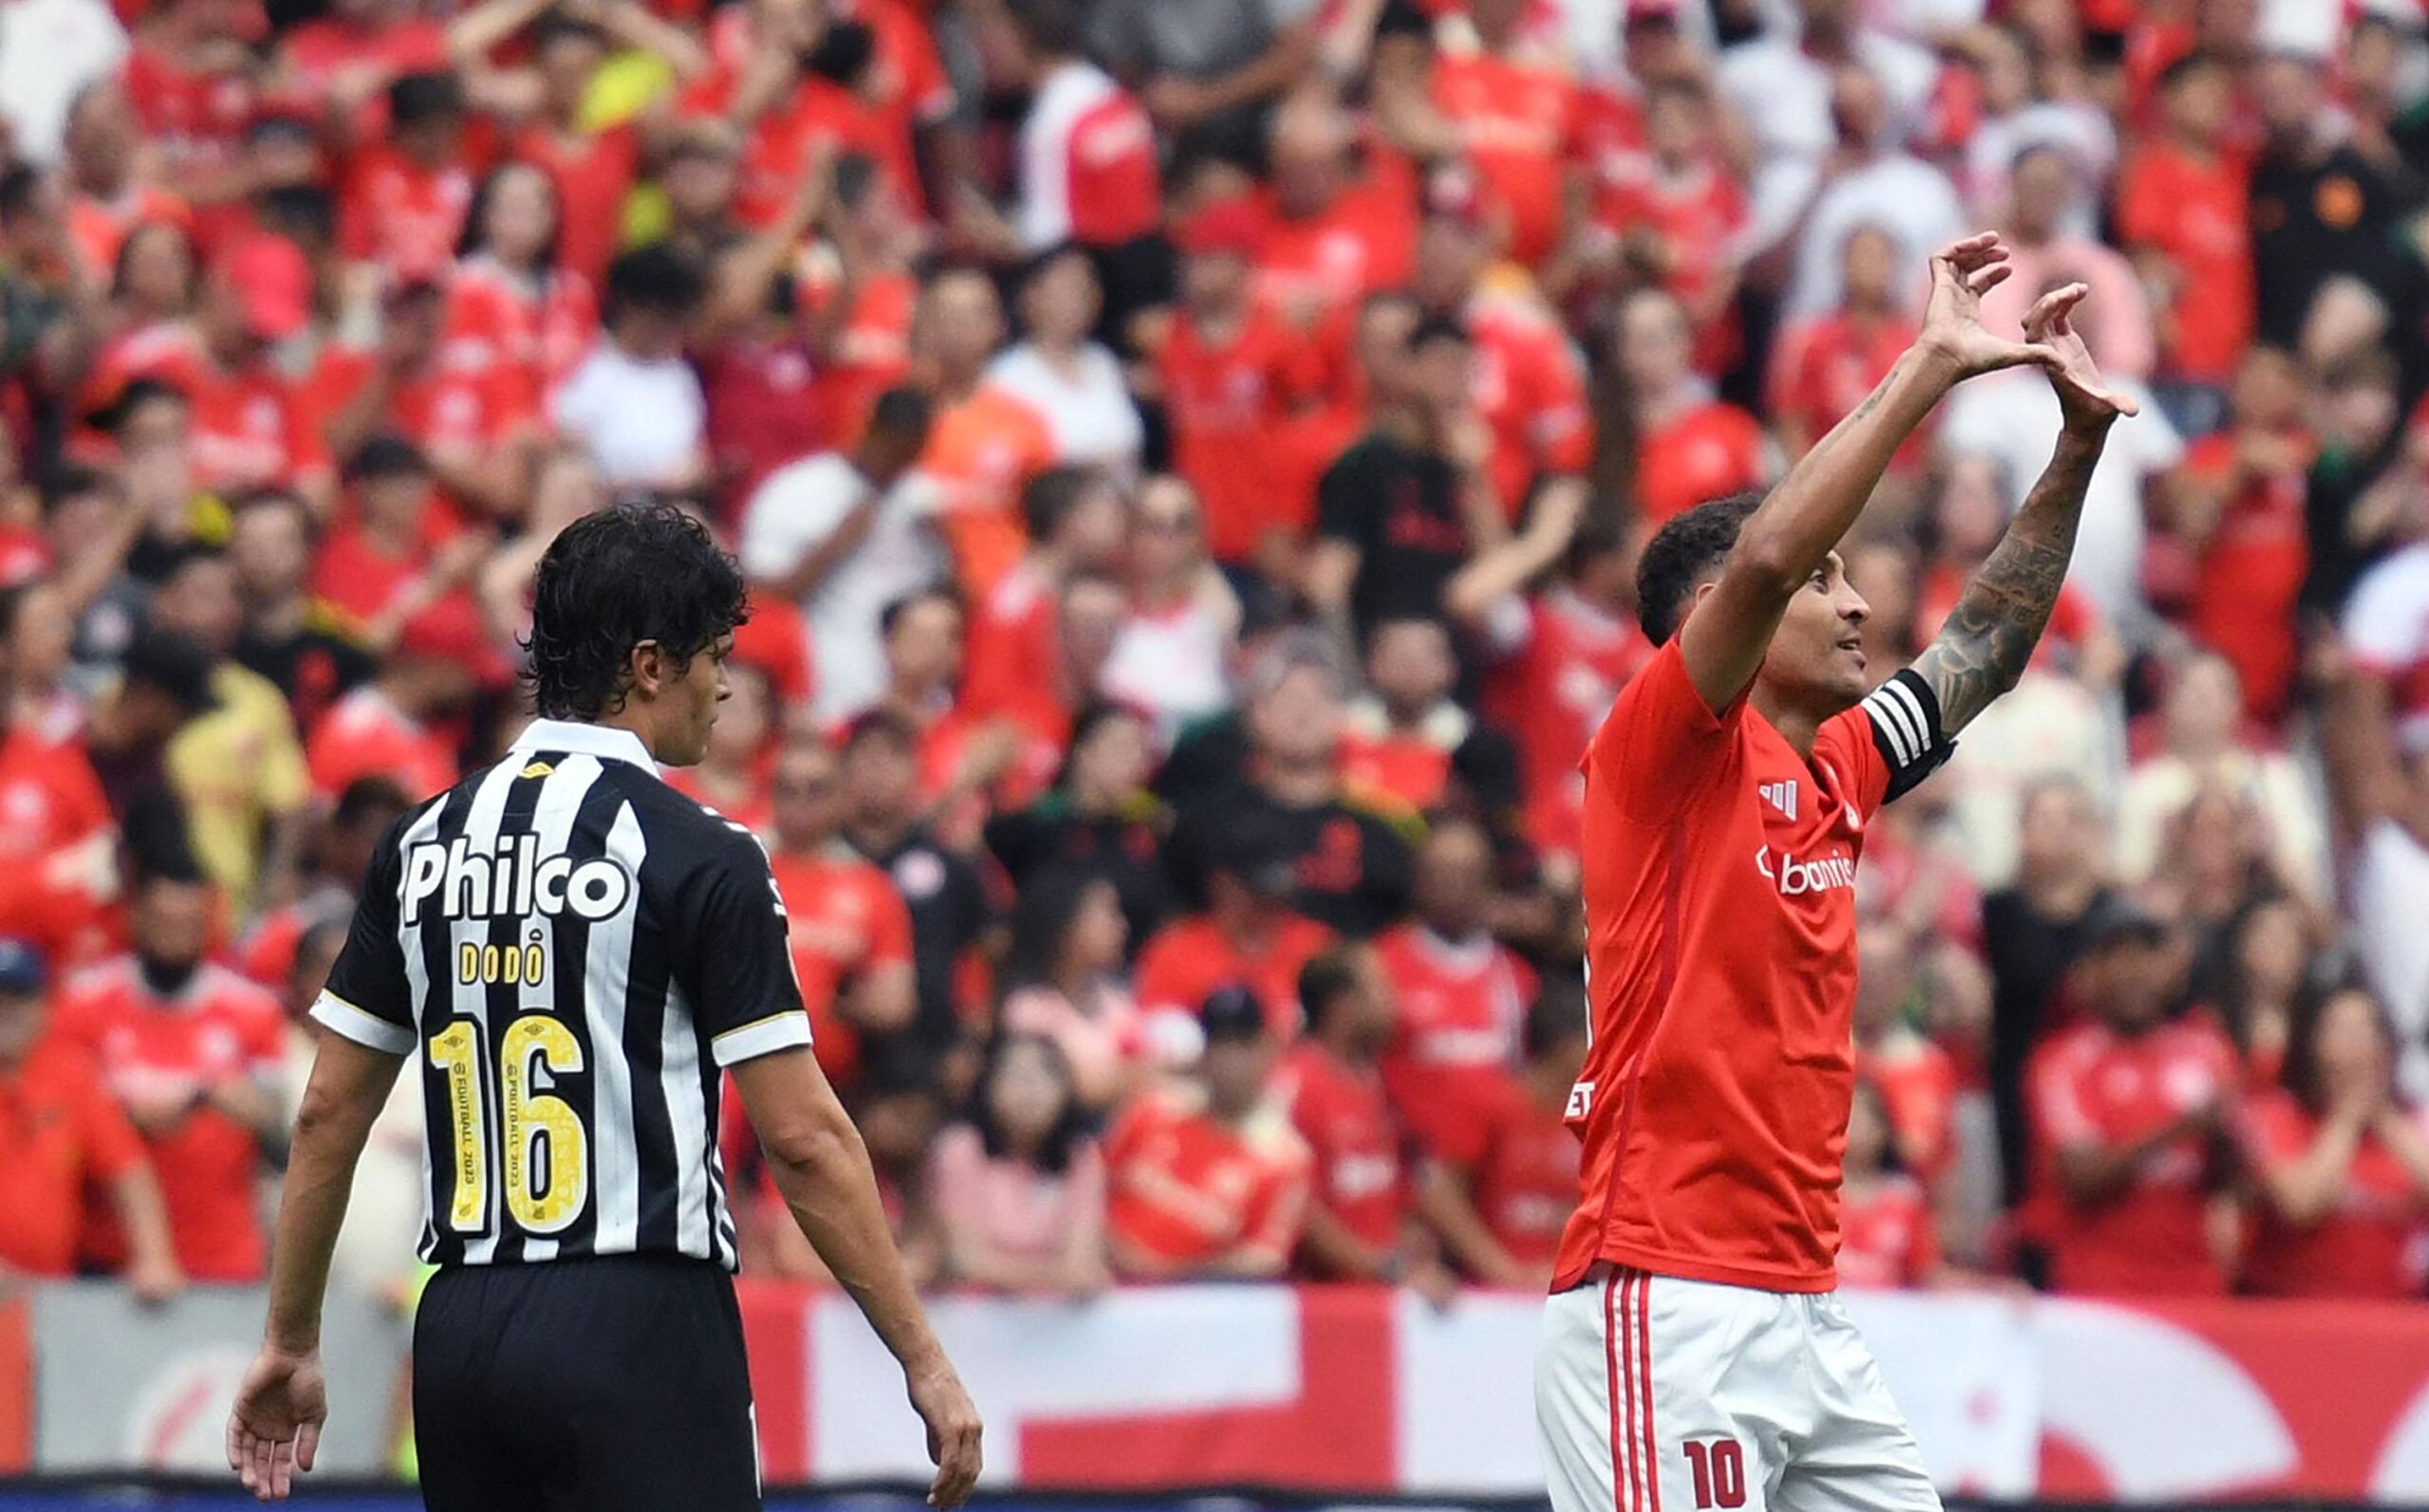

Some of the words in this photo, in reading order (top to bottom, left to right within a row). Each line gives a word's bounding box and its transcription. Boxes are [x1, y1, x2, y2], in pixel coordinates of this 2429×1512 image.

[404, 835, 626, 923] Philco
[461, 930, 543, 985] DODÔ
[429, 1014, 587, 1233] 16
[461, 1151, 475, 1185] 2023
[510, 1154, 520, 1188] 2023
[1682, 1439, 1747, 1509] 10
